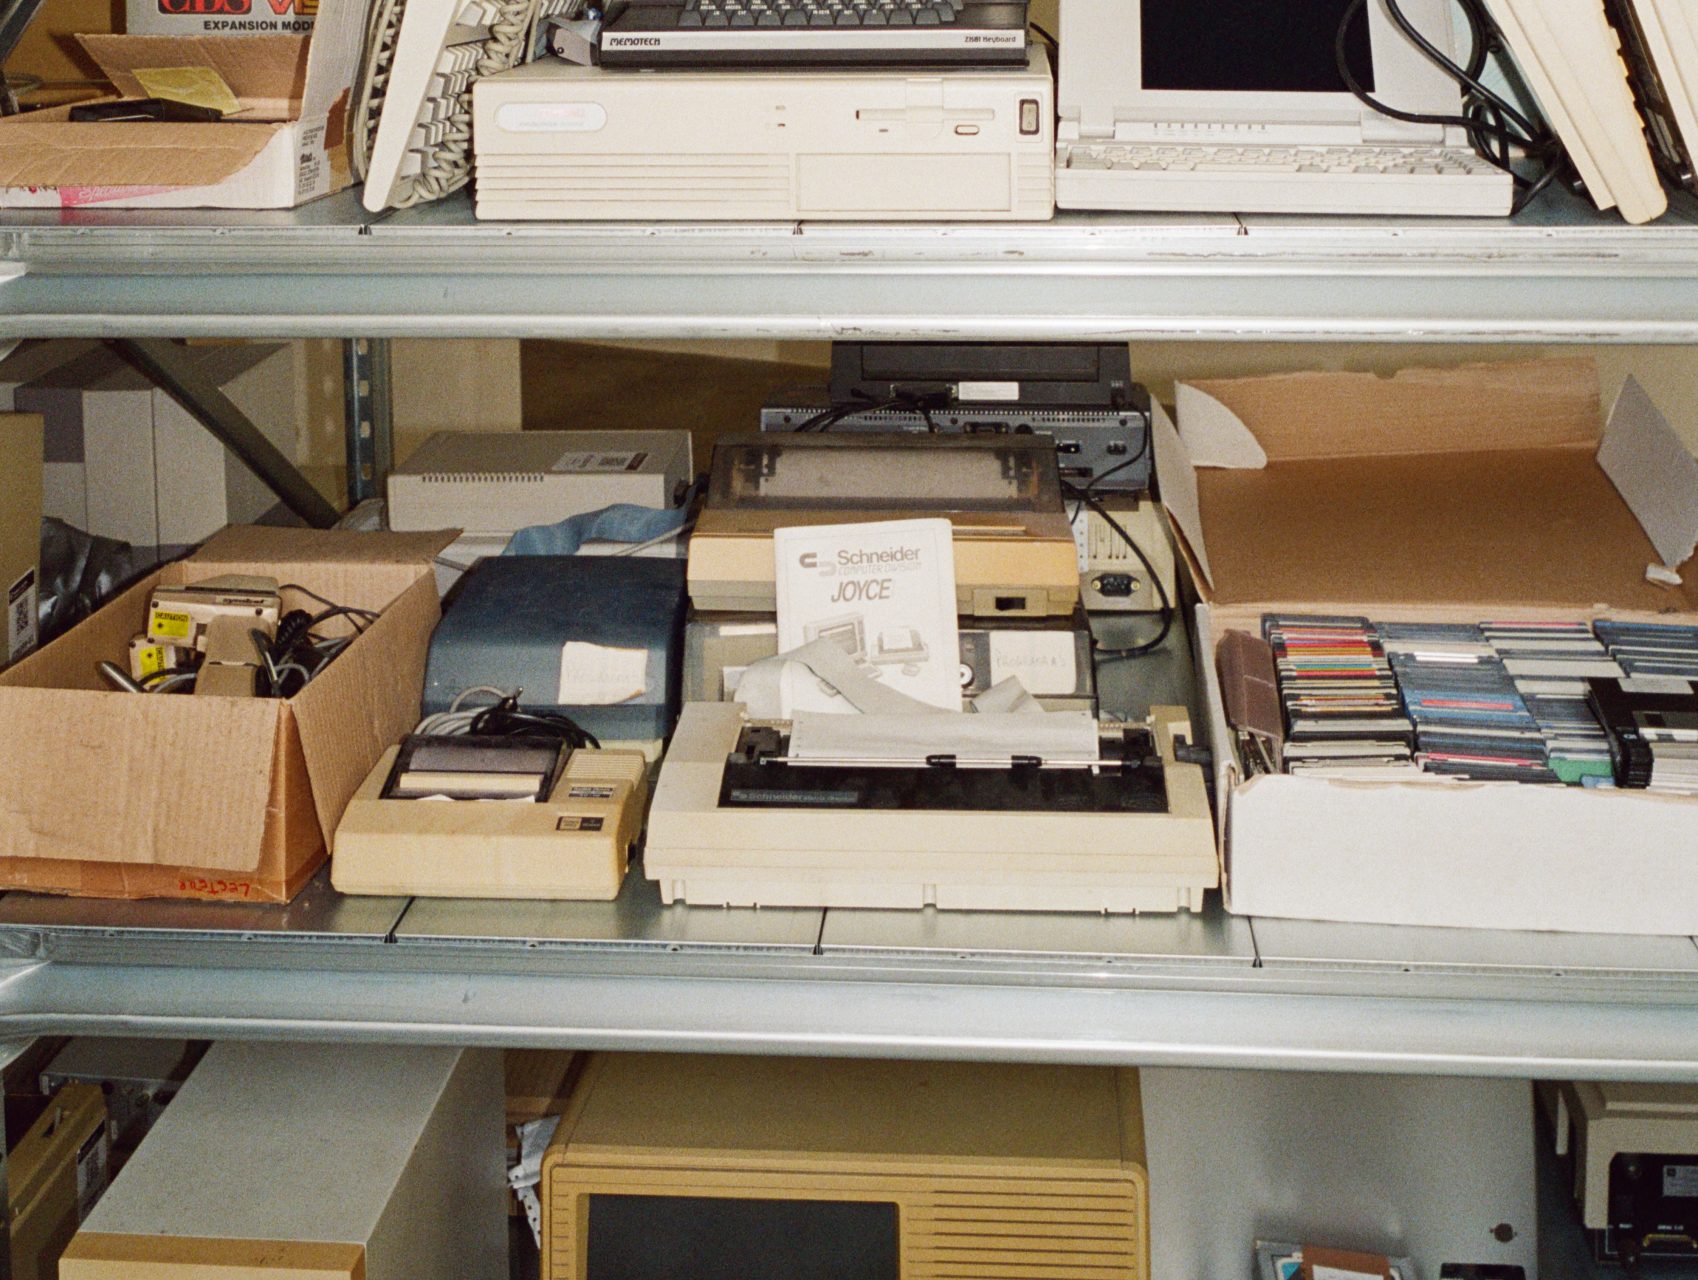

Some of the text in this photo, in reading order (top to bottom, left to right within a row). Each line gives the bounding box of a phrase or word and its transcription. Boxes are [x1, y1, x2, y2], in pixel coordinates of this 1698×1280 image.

[203, 20, 278, 31] EXPANSION
[609, 37, 661, 47] MEMOTECH
[982, 35, 1017, 44] Keyboard
[837, 546, 921, 566] Schneider
[838, 565, 883, 576] COMPUTER
[831, 578, 892, 603] JOYCE
